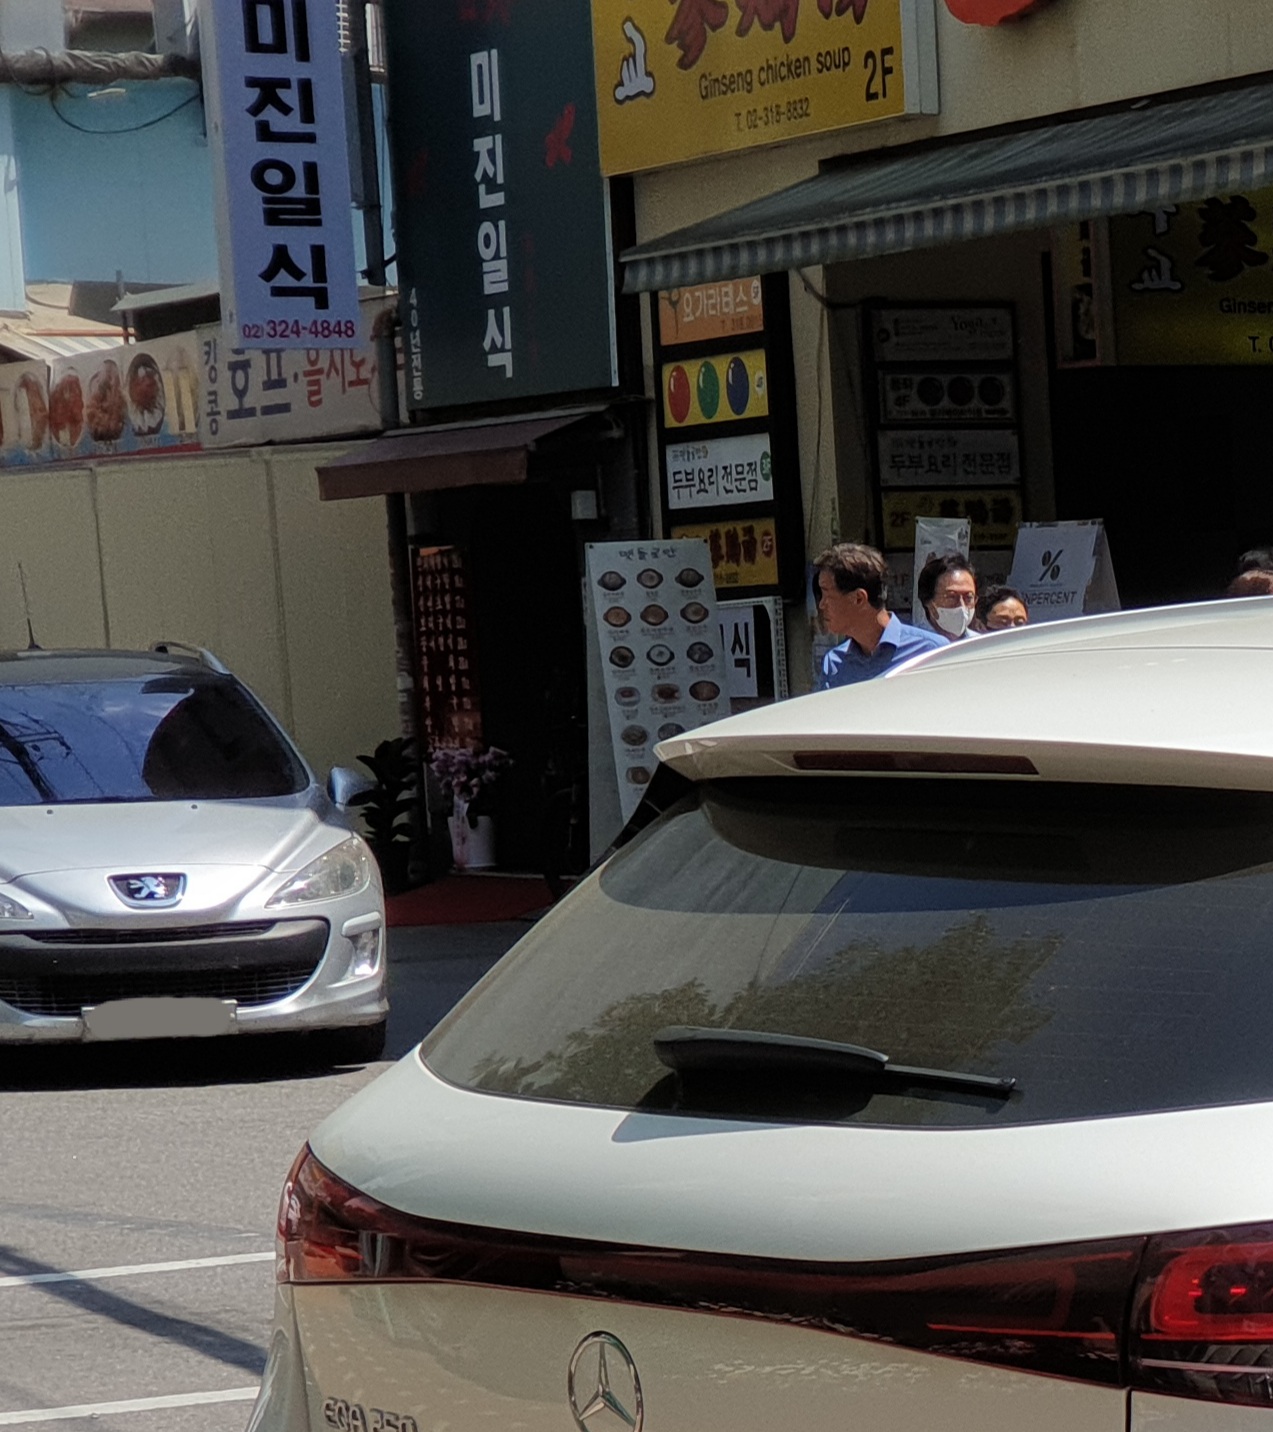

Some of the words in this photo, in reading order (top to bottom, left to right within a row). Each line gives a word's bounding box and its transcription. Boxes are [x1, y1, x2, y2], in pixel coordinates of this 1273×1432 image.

[699, 66, 753, 100] Ginseng
[757, 51, 812, 87] chicken
[815, 46, 851, 73] soup
[863, 46, 895, 103] 2F
[242, 0, 330, 310] 미진일식
[469, 48, 514, 379] 미진일식
[671, 463, 720, 500] 두부요리
[722, 460, 759, 494] 전문점
[1020, 590, 1077, 605] NPERCENT
